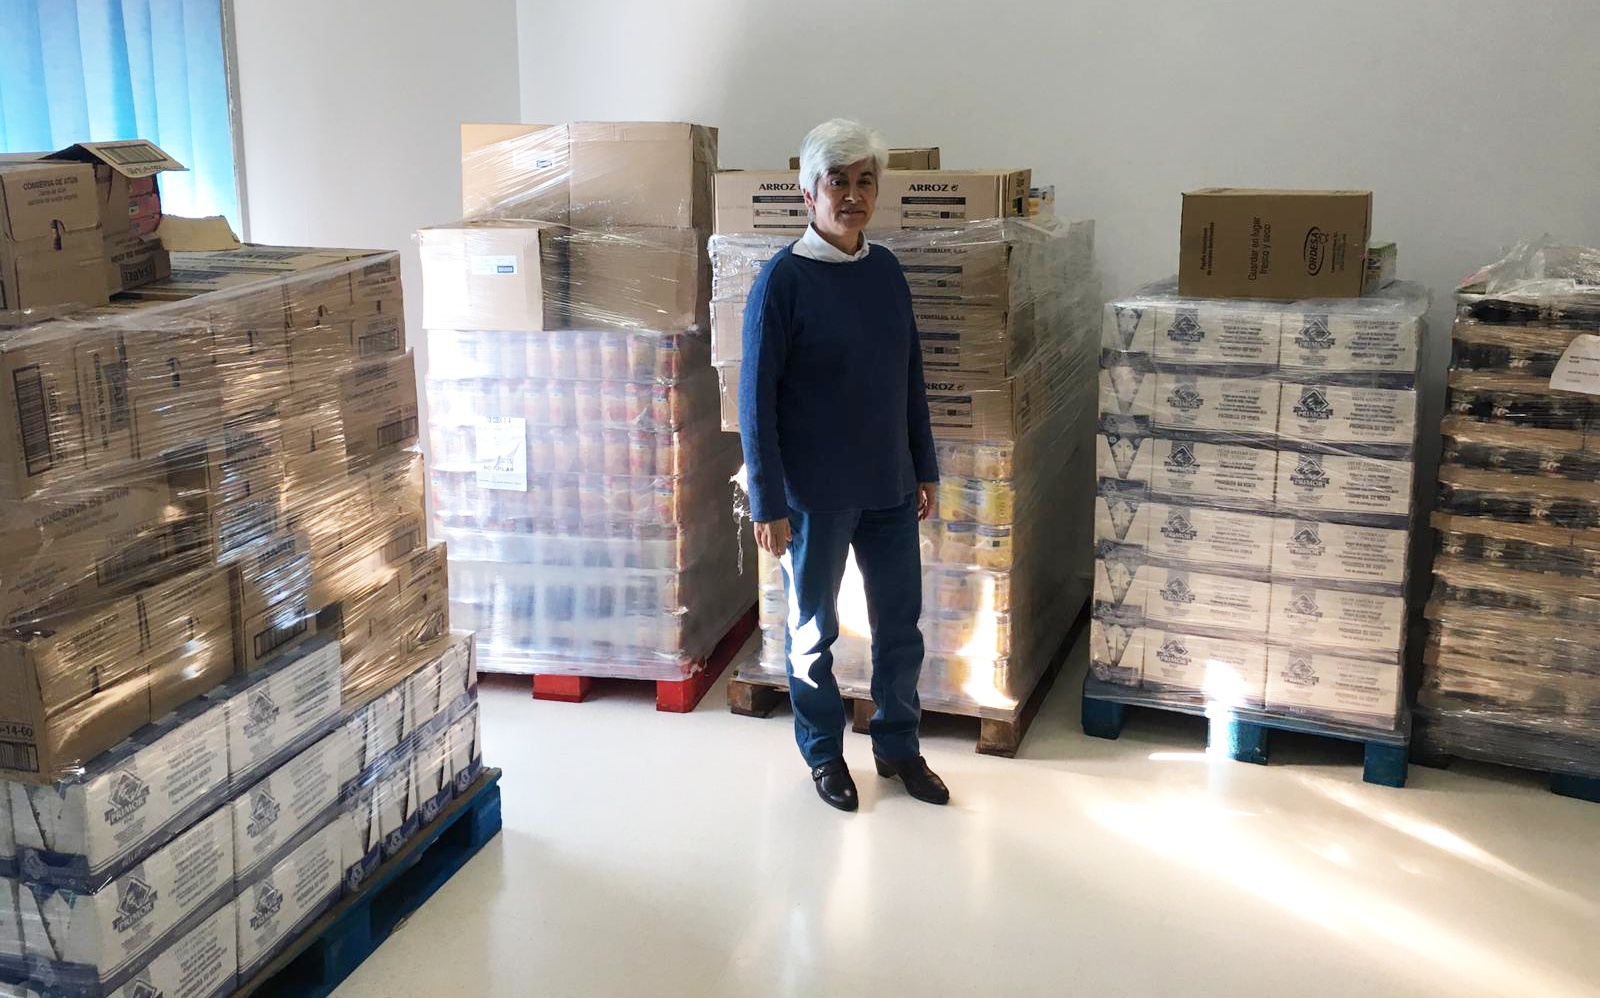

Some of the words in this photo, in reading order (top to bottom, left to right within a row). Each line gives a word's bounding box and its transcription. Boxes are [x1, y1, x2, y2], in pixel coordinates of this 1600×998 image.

[759, 183, 797, 191] ARROZ
[1250, 217, 1262, 237] lugar
[1263, 224, 1271, 243] seco
[1251, 238, 1259, 248] en
[1309, 232, 1319, 271] ORDESA
[1248, 250, 1258, 281] Guardar
[1259, 251, 1269, 274] fresco
